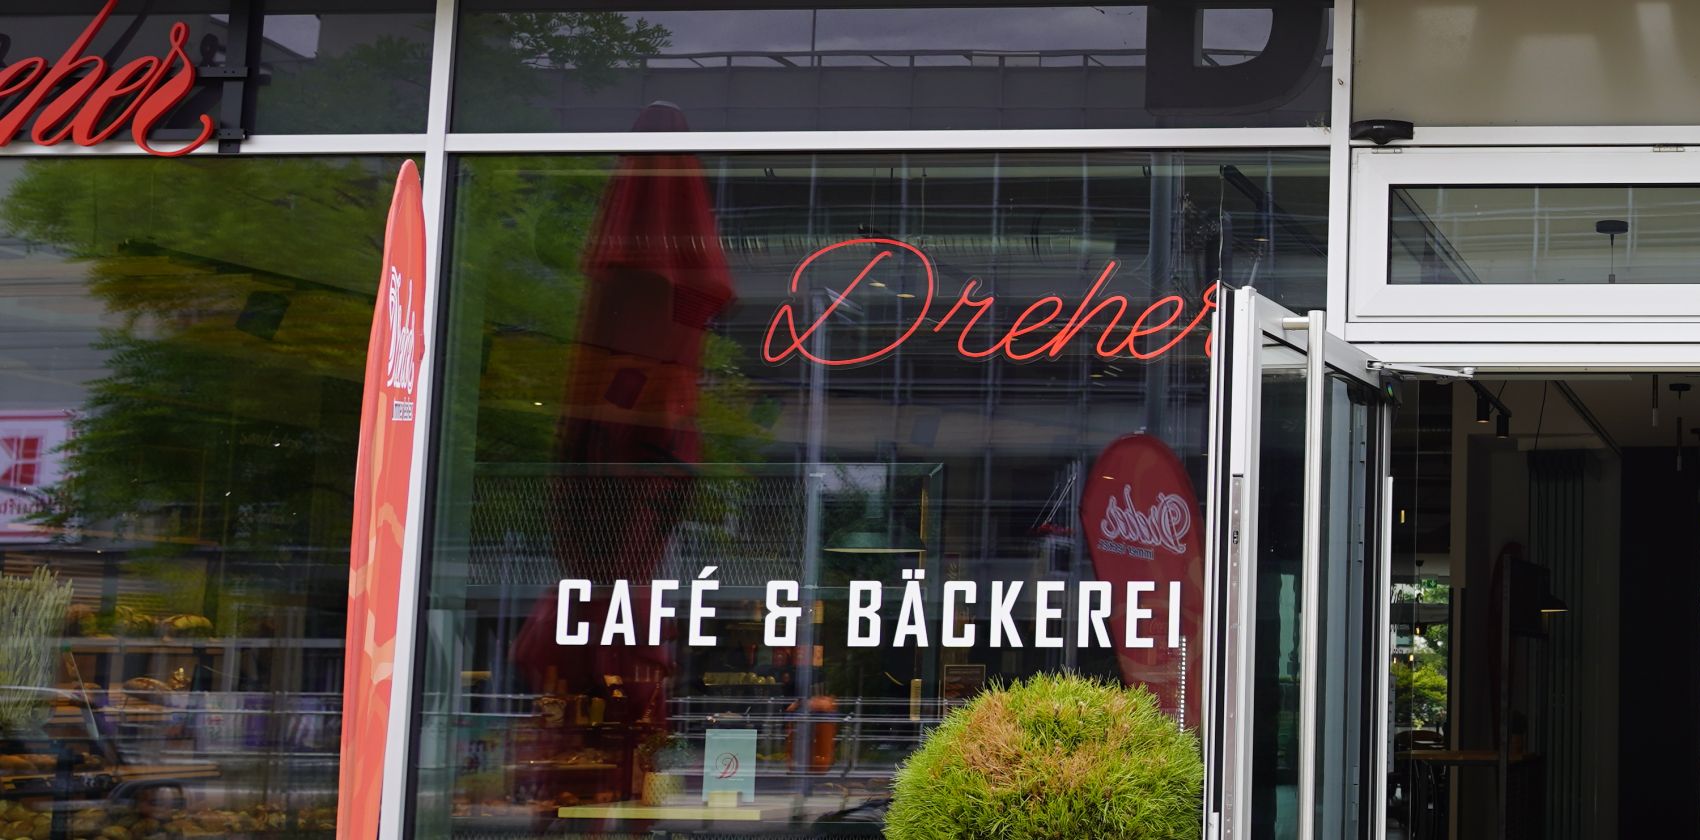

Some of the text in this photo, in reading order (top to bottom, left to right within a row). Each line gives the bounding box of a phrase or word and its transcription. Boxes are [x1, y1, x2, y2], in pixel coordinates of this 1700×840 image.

[555, 566, 1181, 648] CAFÉ & BÄCKEREI
